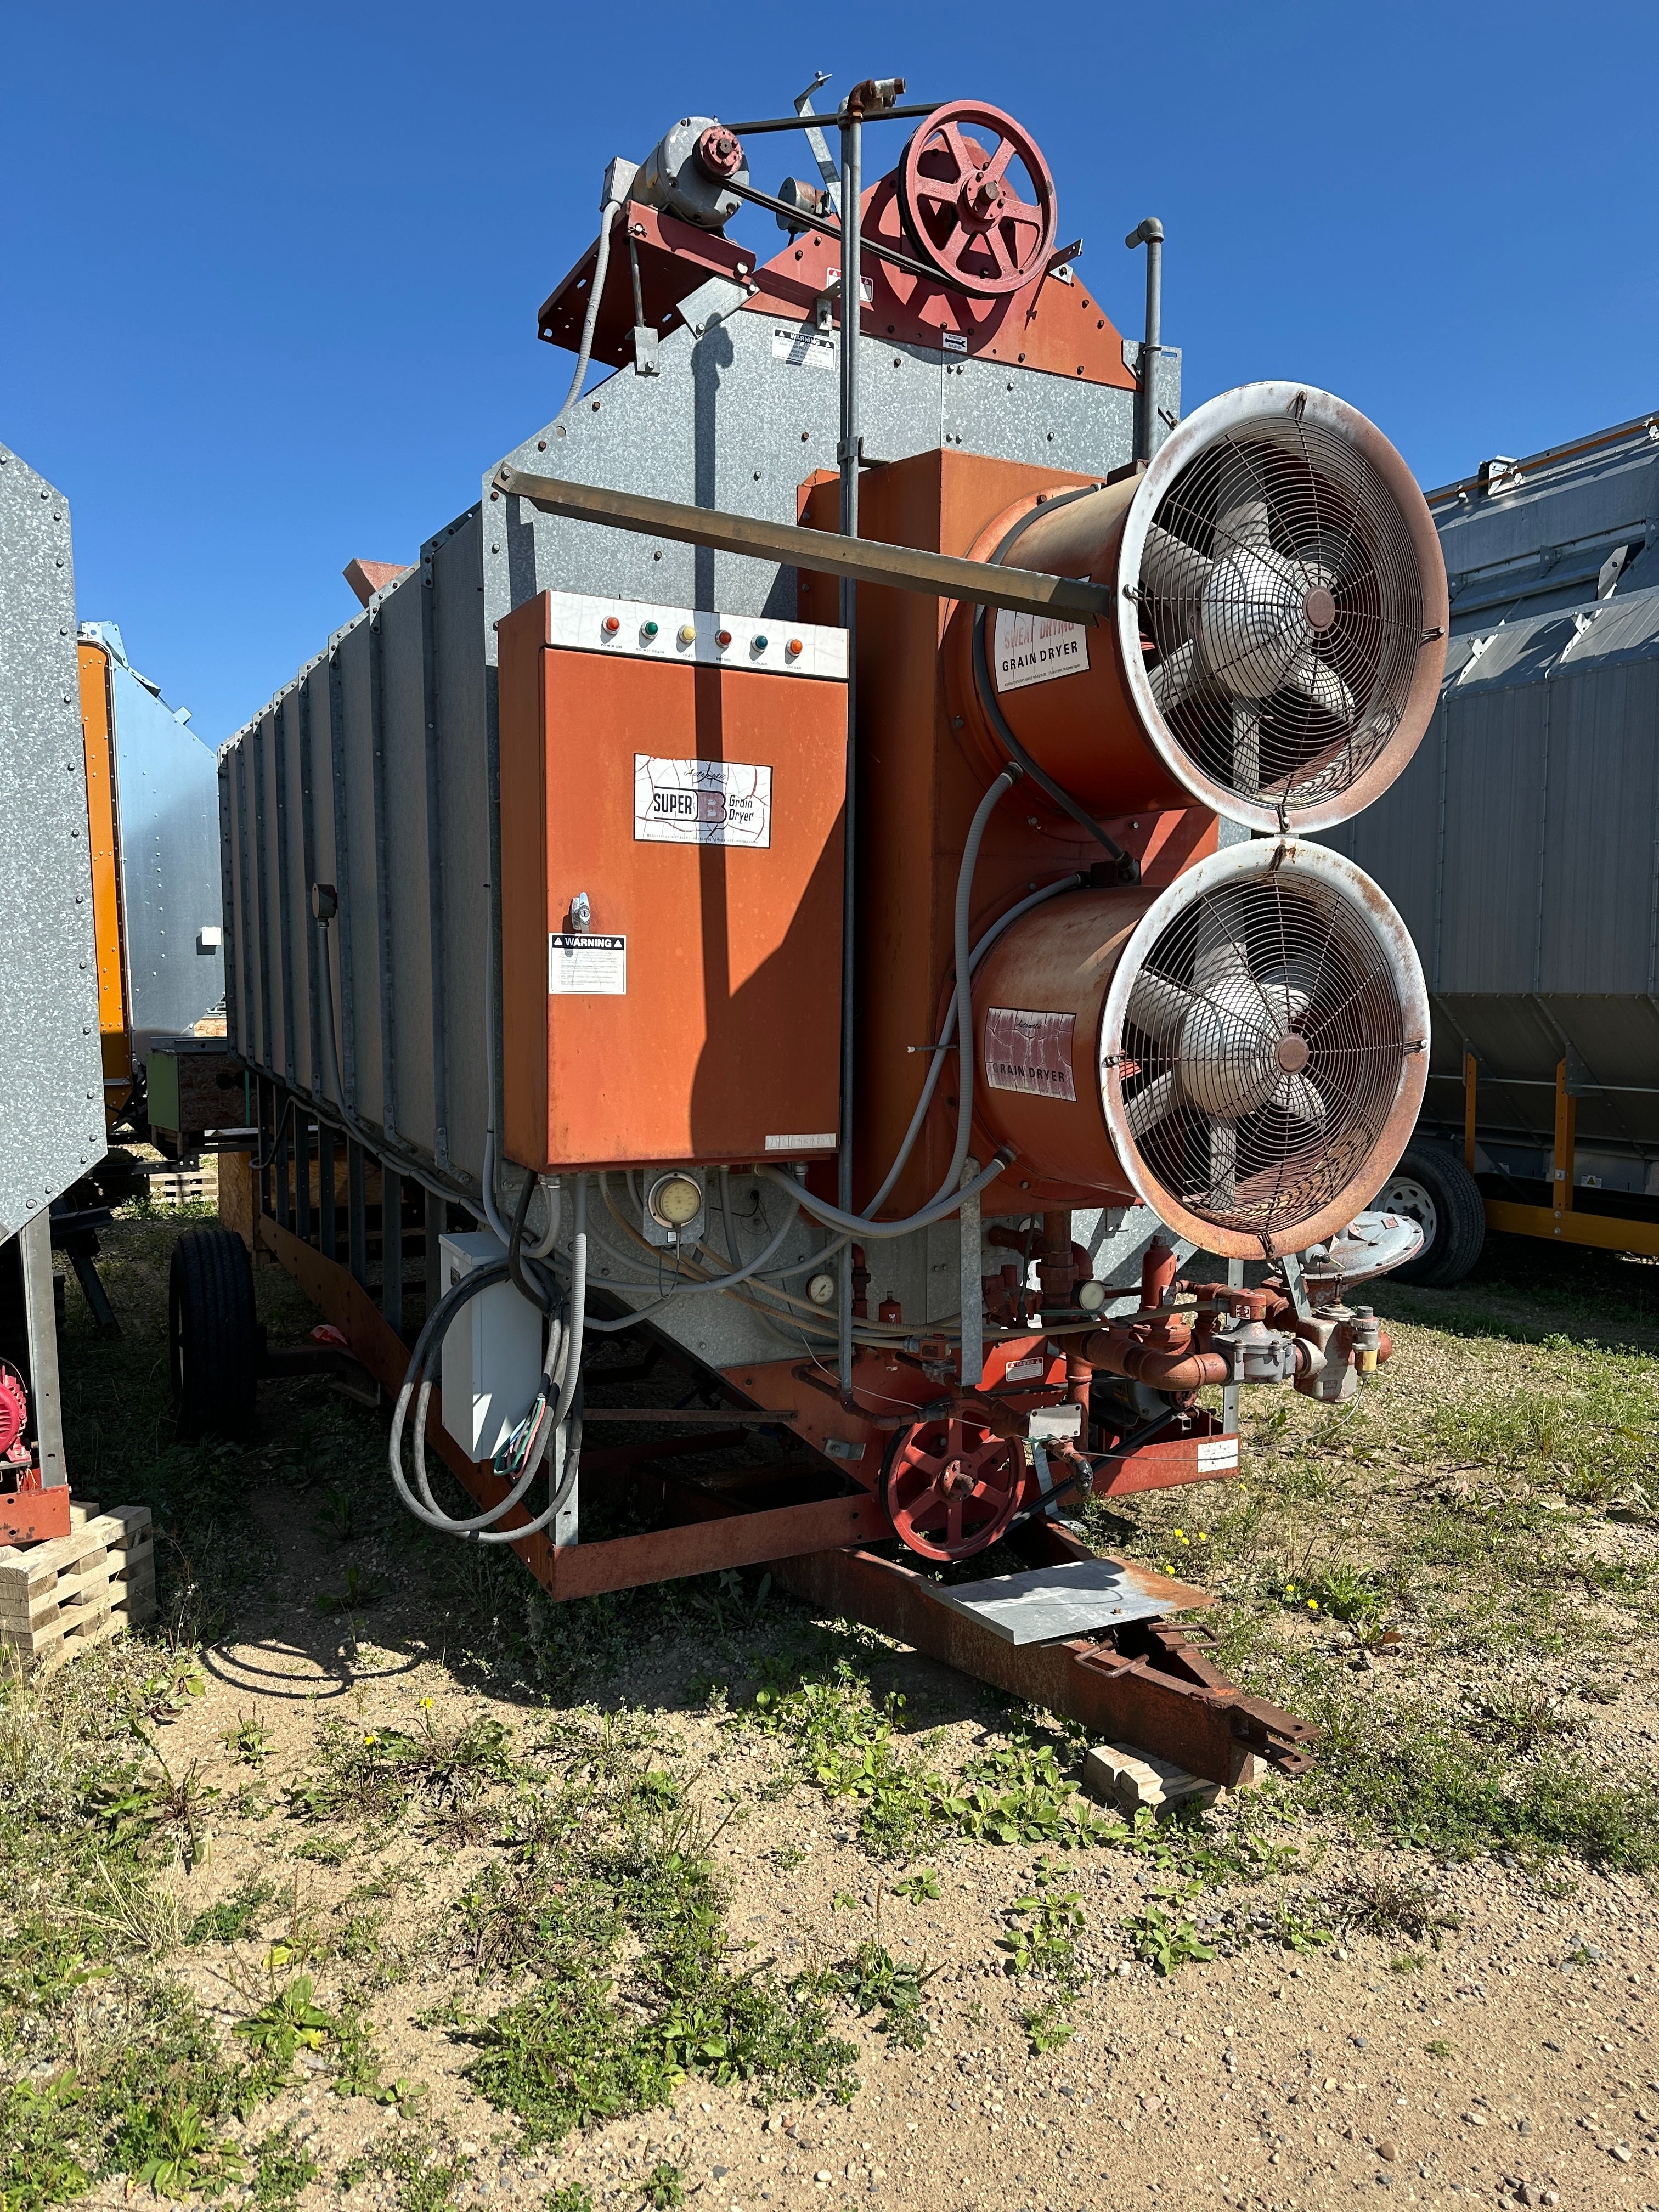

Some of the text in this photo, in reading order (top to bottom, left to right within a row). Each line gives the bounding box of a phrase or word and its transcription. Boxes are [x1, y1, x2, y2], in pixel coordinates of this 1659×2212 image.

[790, 333, 820, 345] WARNING
[1005, 623, 1035, 650] SWEAT
[1002, 652, 1036, 672] GRAIN
[1039, 640, 1079, 662] DRYER
[684, 768, 726, 780] Automatic
[653, 791, 727, 824] SUPER B
[729, 794, 753, 809] Grain
[729, 809, 754, 824] Dryer
[565, 937, 612, 947] WARNING
[992, 1062, 1065, 1082] GRAIN DRYER
